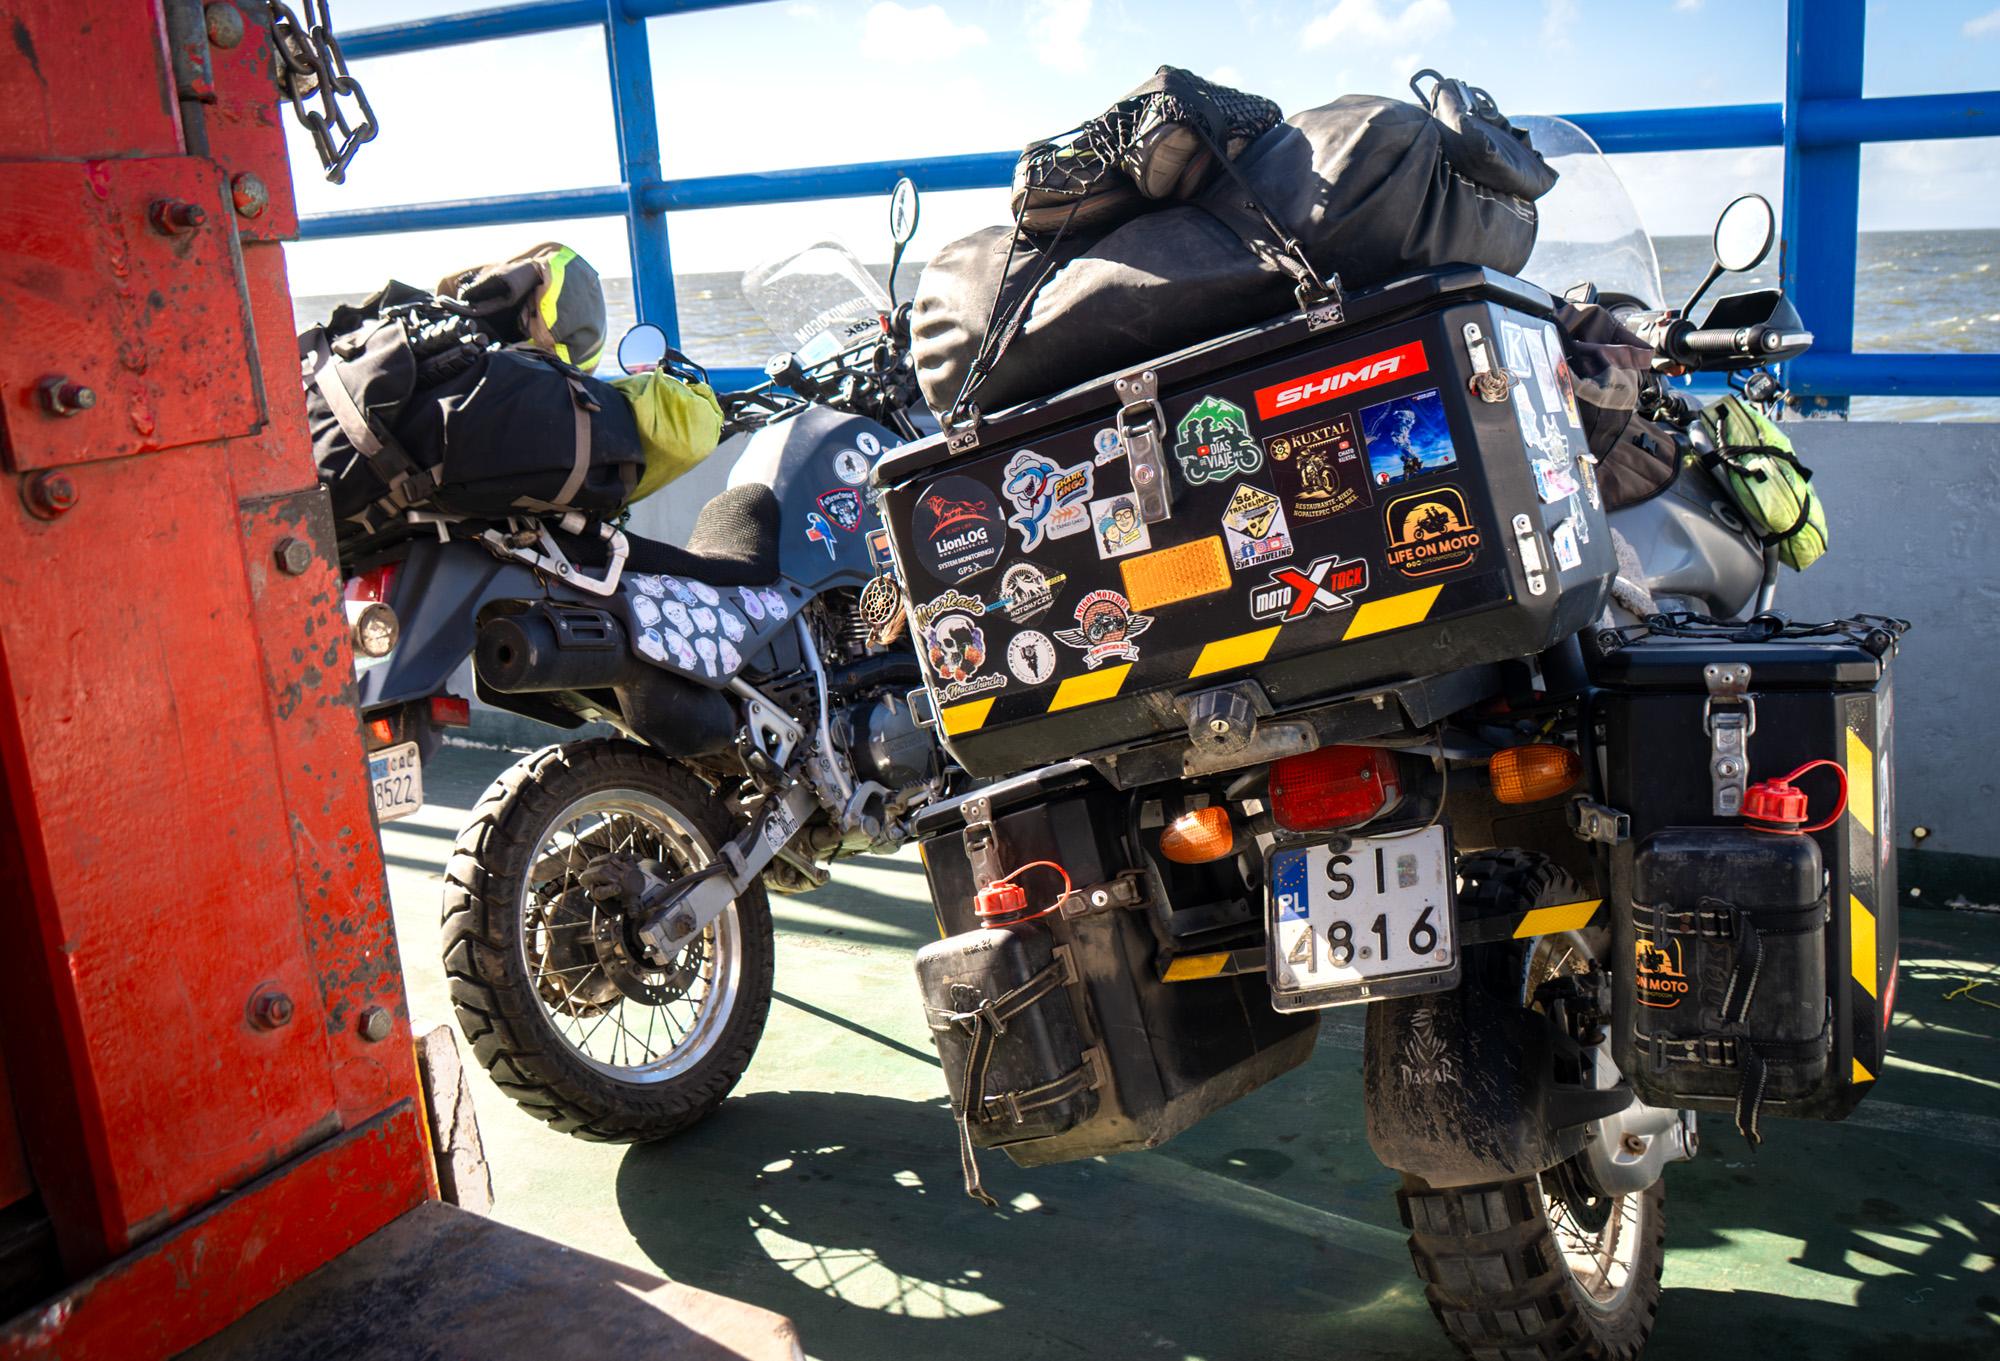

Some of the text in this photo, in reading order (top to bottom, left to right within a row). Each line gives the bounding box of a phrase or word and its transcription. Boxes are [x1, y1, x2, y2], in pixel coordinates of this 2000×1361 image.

[1276, 355, 1401, 408] SHIMA
[1292, 423, 1349, 448] KUXTAL
[1207, 451, 1234, 469] VIAJE
[1055, 467, 1085, 490] SHARK
[1229, 495, 1270, 515] TRAVELING
[1236, 491, 1259, 505] S&A
[936, 527, 988, 554] LionLOG
[1387, 533, 1480, 566] LIFE ON MOTO
[937, 558, 958, 571] SYSTEM
[1251, 547, 1293, 565] TRAVELING
[957, 564, 973, 576] GPS
[1075, 590, 1130, 619] AMIGOS MOTEROS
[1256, 586, 1292, 613] MOTO
[1326, 847, 1385, 901] SI
[1278, 891, 1306, 917] PL
[1287, 905, 1438, 974] 4816
[1649, 978, 1689, 994] MOTO
[1400, 1057, 1457, 1090] DAKAR
